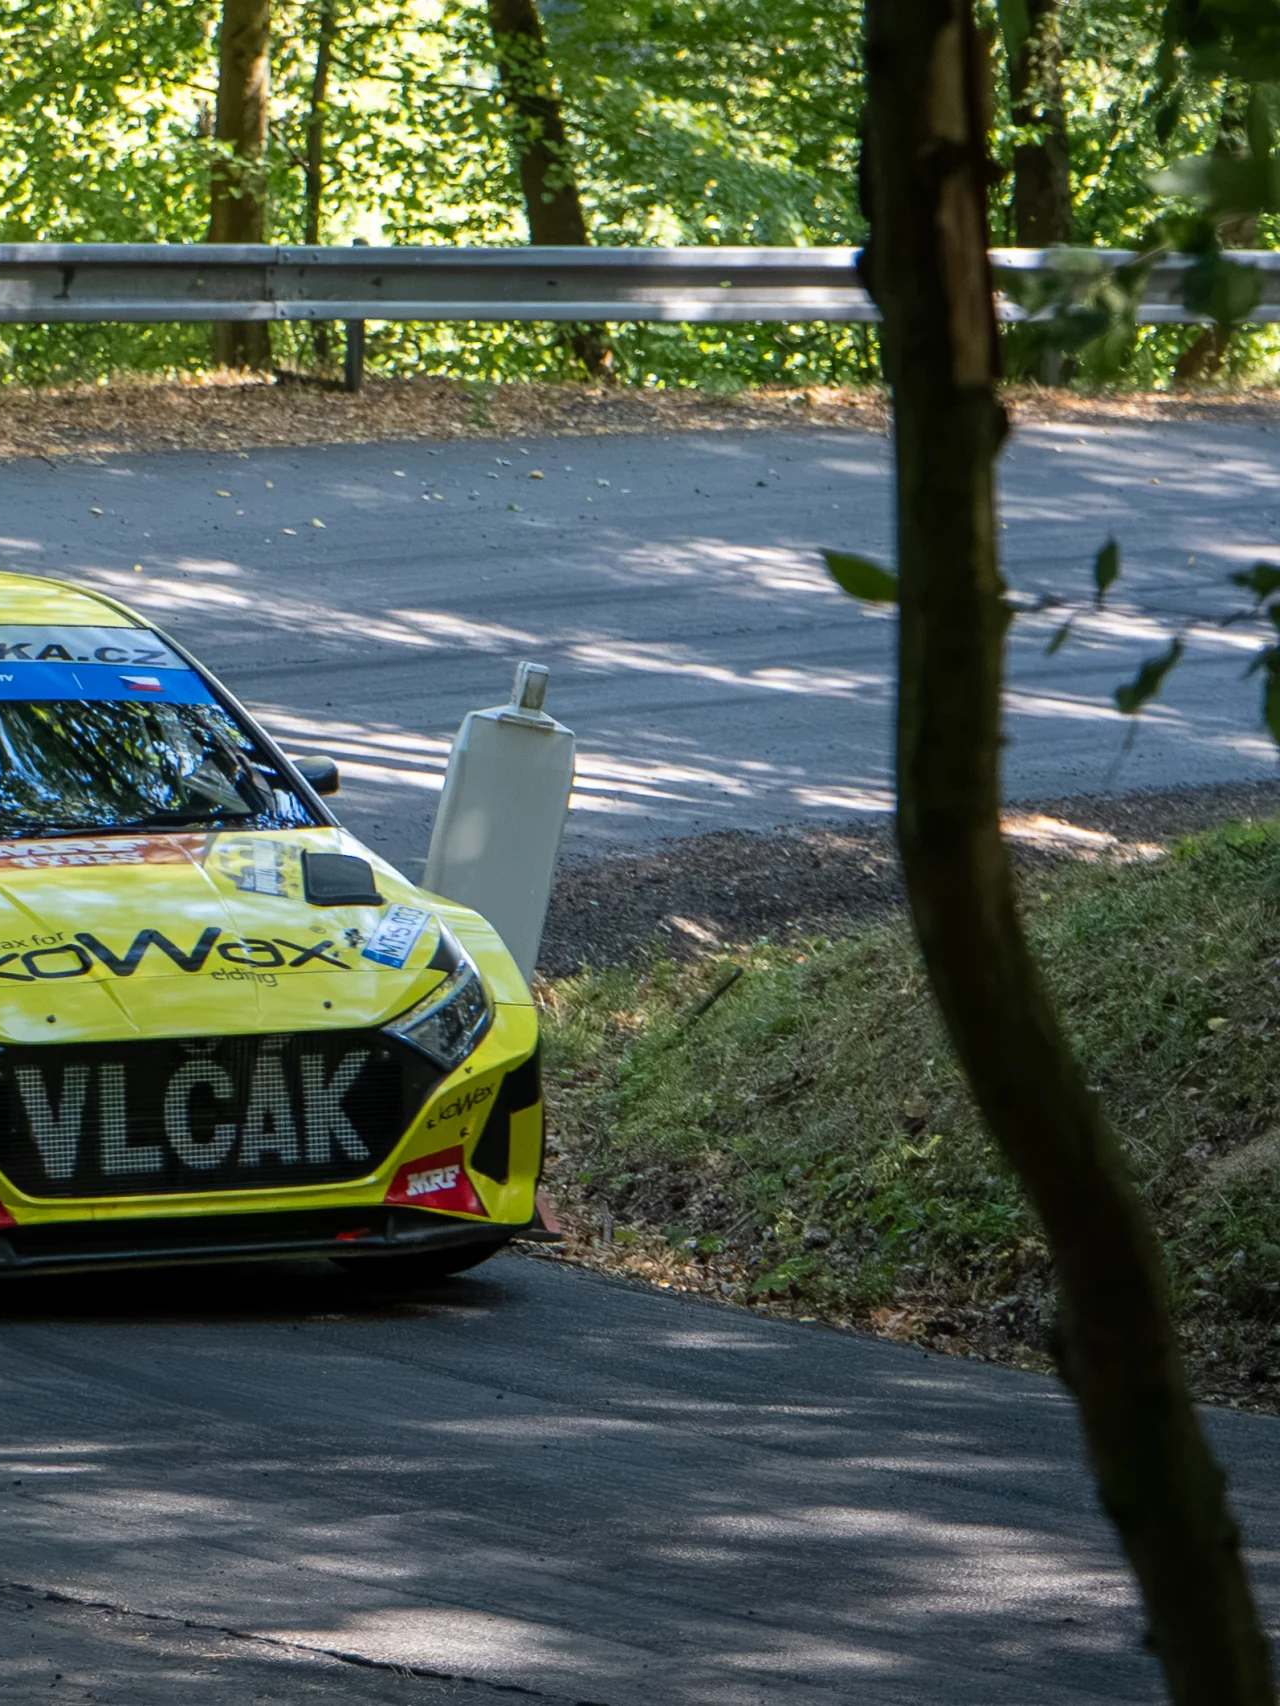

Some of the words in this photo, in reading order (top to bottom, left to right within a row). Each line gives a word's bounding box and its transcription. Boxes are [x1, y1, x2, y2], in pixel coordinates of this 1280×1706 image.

[11, 851, 145, 869] TYRES
[30, 930, 67, 947] for
[405, 1164, 461, 1197] MRF
